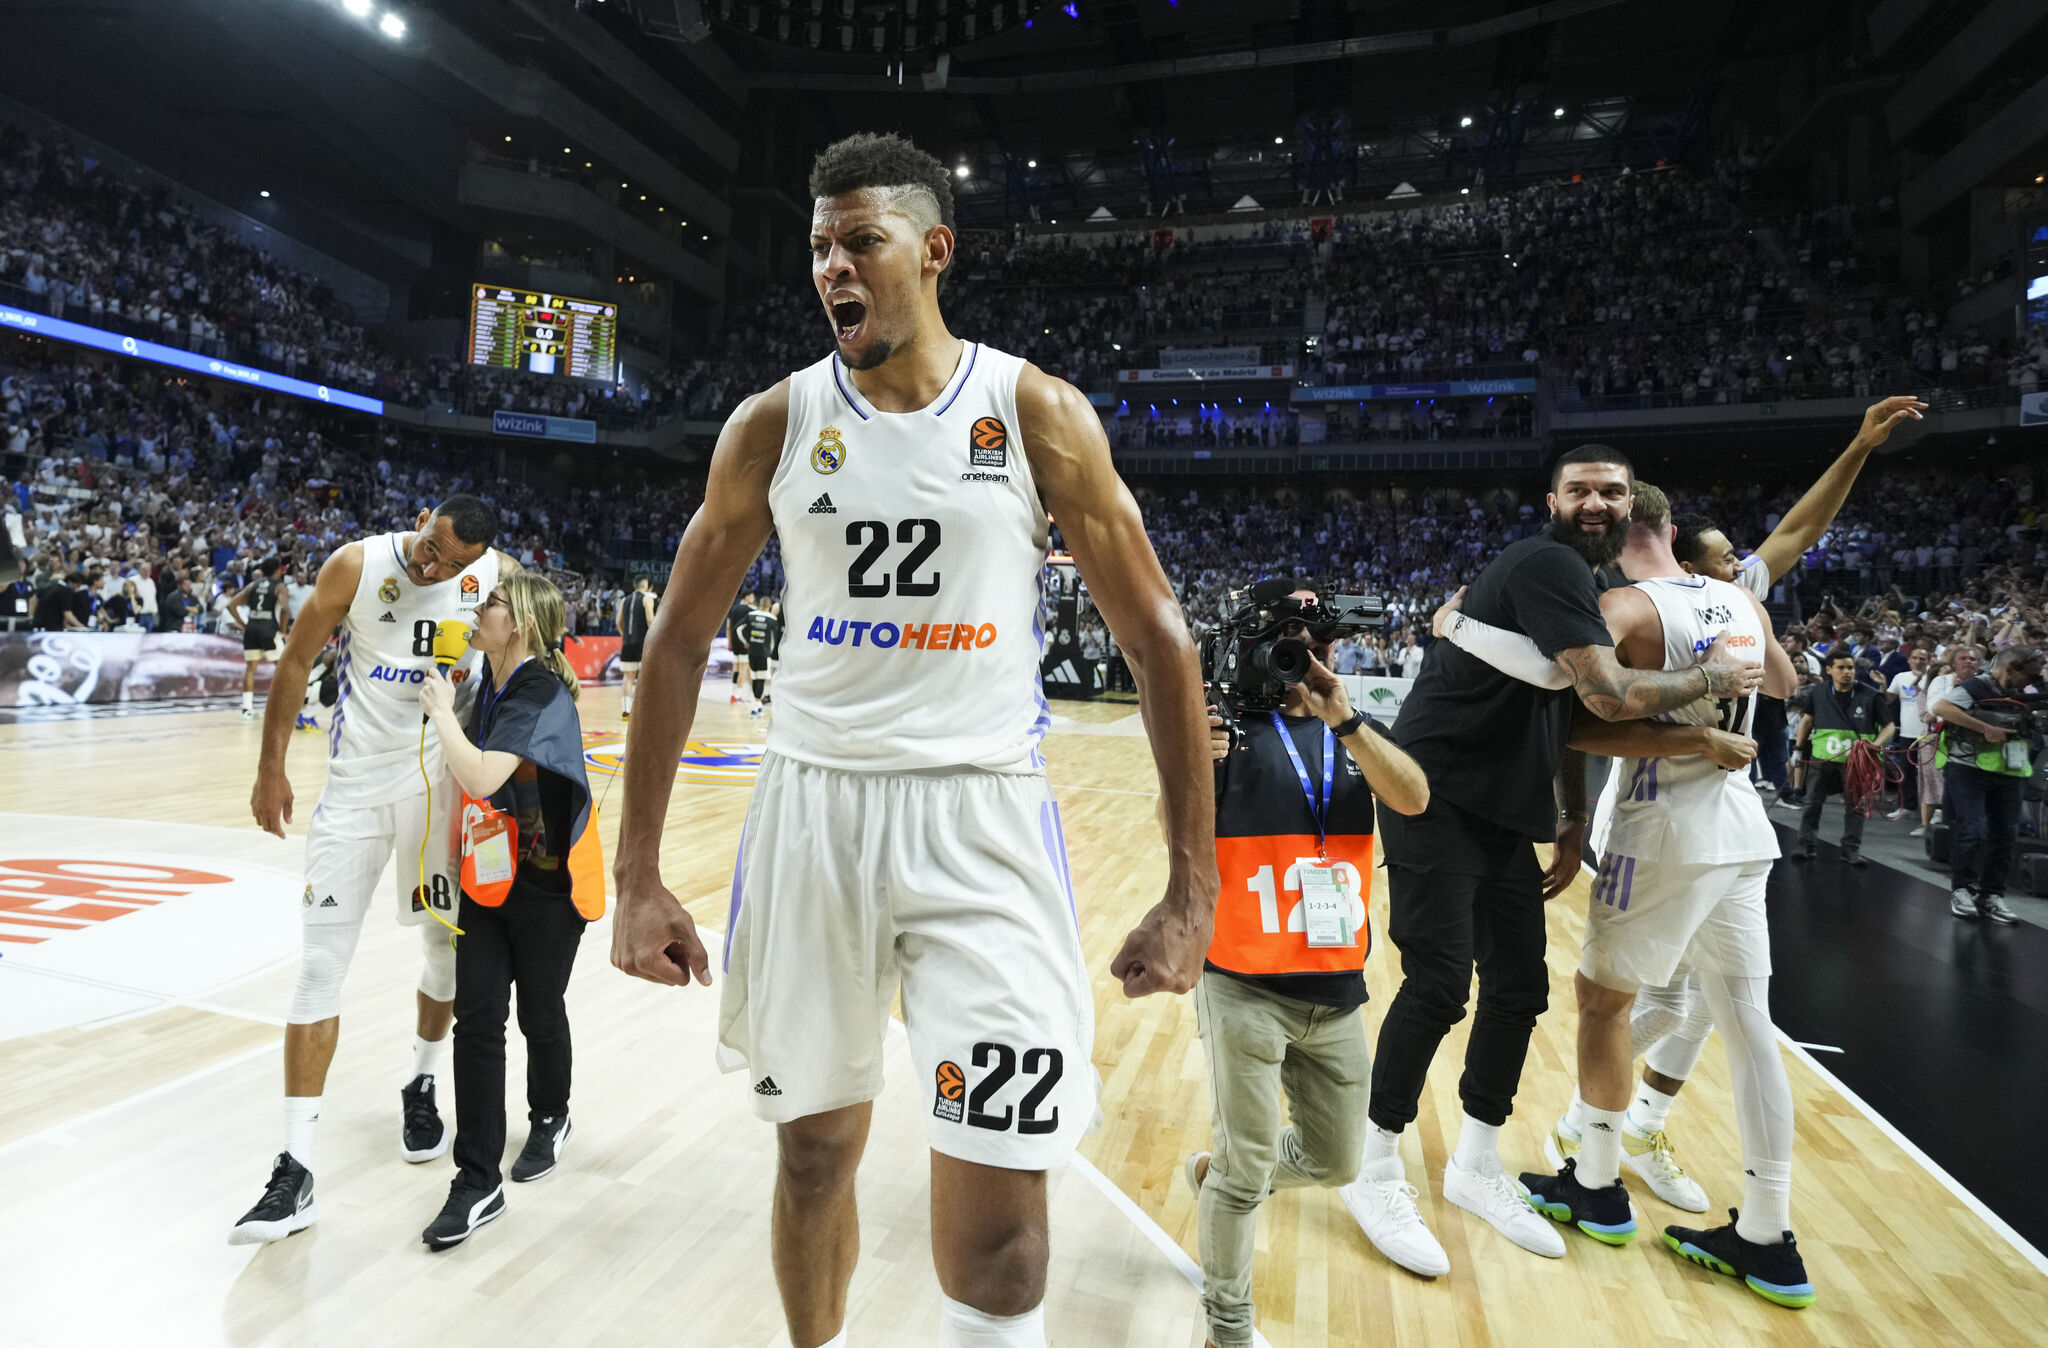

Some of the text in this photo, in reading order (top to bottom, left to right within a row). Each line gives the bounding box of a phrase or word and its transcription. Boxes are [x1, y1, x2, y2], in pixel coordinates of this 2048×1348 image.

[1223, 367, 1257, 377] Madrid
[974, 448, 1003, 456] TURKISH
[961, 472, 1009, 483] oneteam
[808, 505, 837, 514] adidas
[846, 518, 941, 598] 22
[807, 615, 998, 651] AUTOHERO
[369, 665, 471, 684] AUTORO
[432, 873, 452, 911] 8
[754, 1084, 783, 1096] adidas
[967, 1041, 1064, 1135] 22
